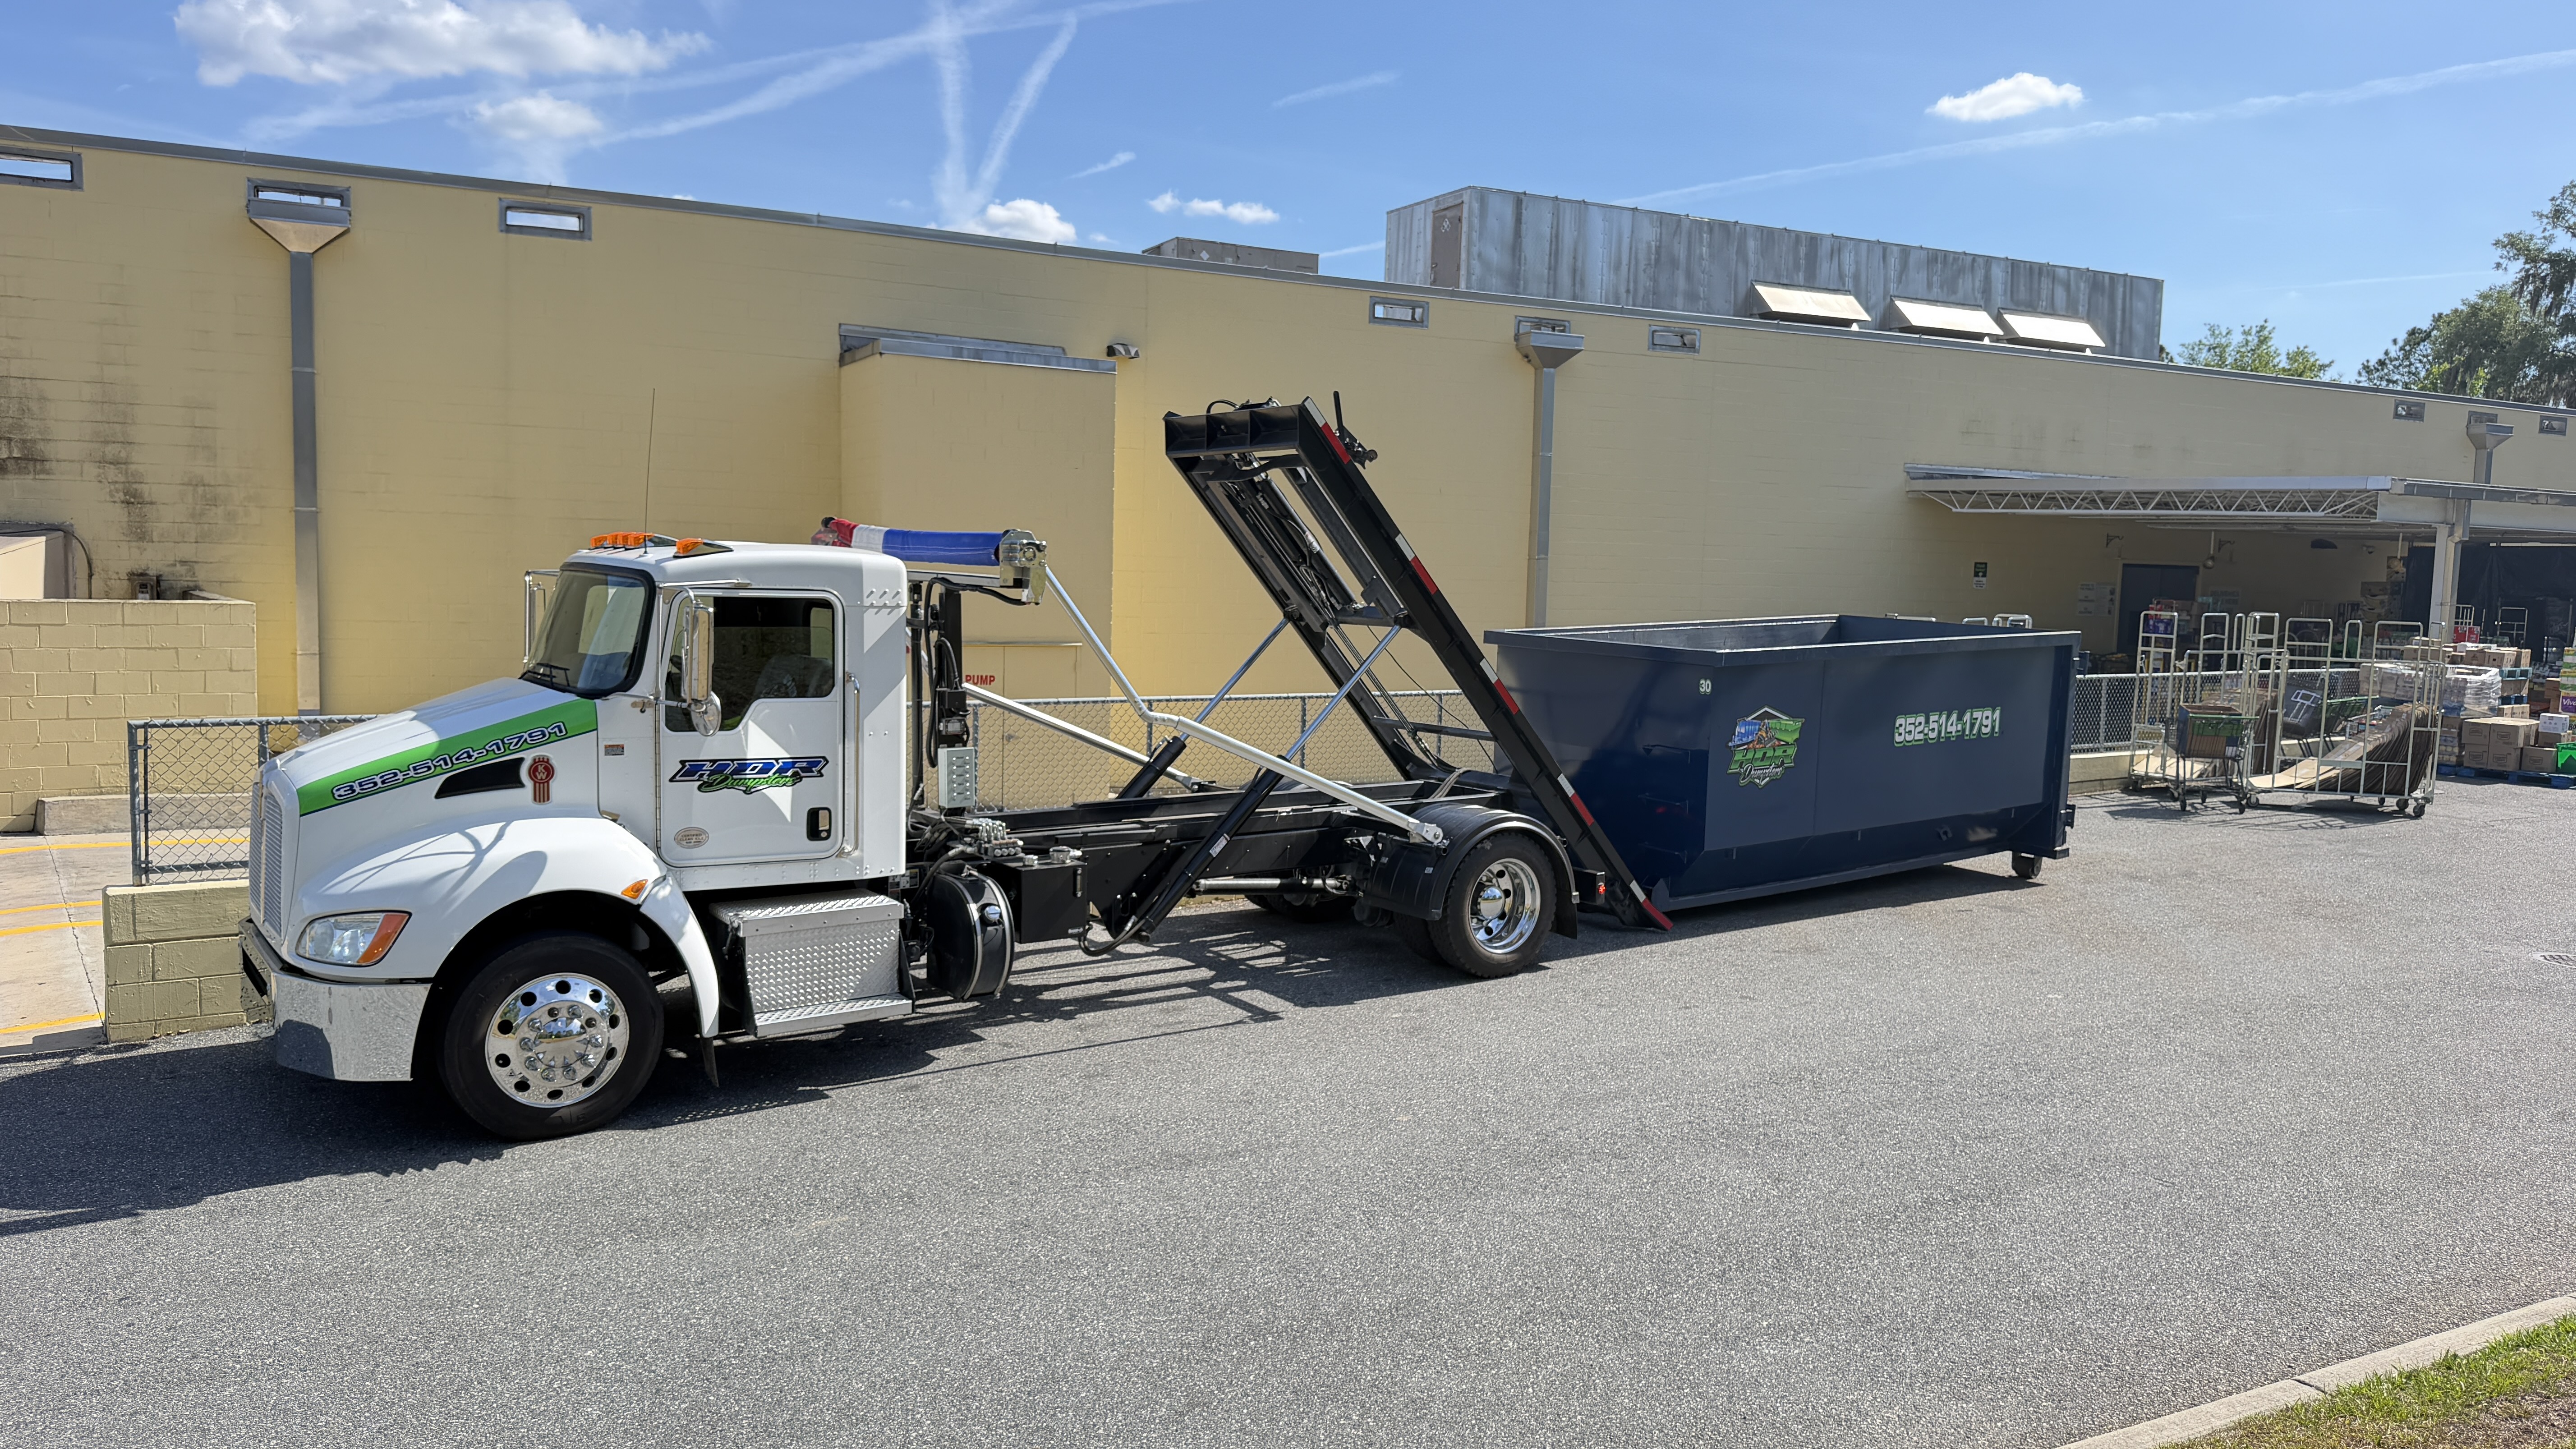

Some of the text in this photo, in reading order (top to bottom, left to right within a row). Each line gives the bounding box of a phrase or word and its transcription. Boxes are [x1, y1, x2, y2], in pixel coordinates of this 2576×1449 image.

[966, 675, 995, 685] PUMP
[1699, 679, 1711, 695] 30
[1895, 708, 2001, 745] 352-514-1791
[333, 722, 566, 800] 352-514-1791
[1730, 744, 1796, 770] HDR
[672, 758, 828, 782] HDR
[699, 773, 797, 792] Dumpsters
